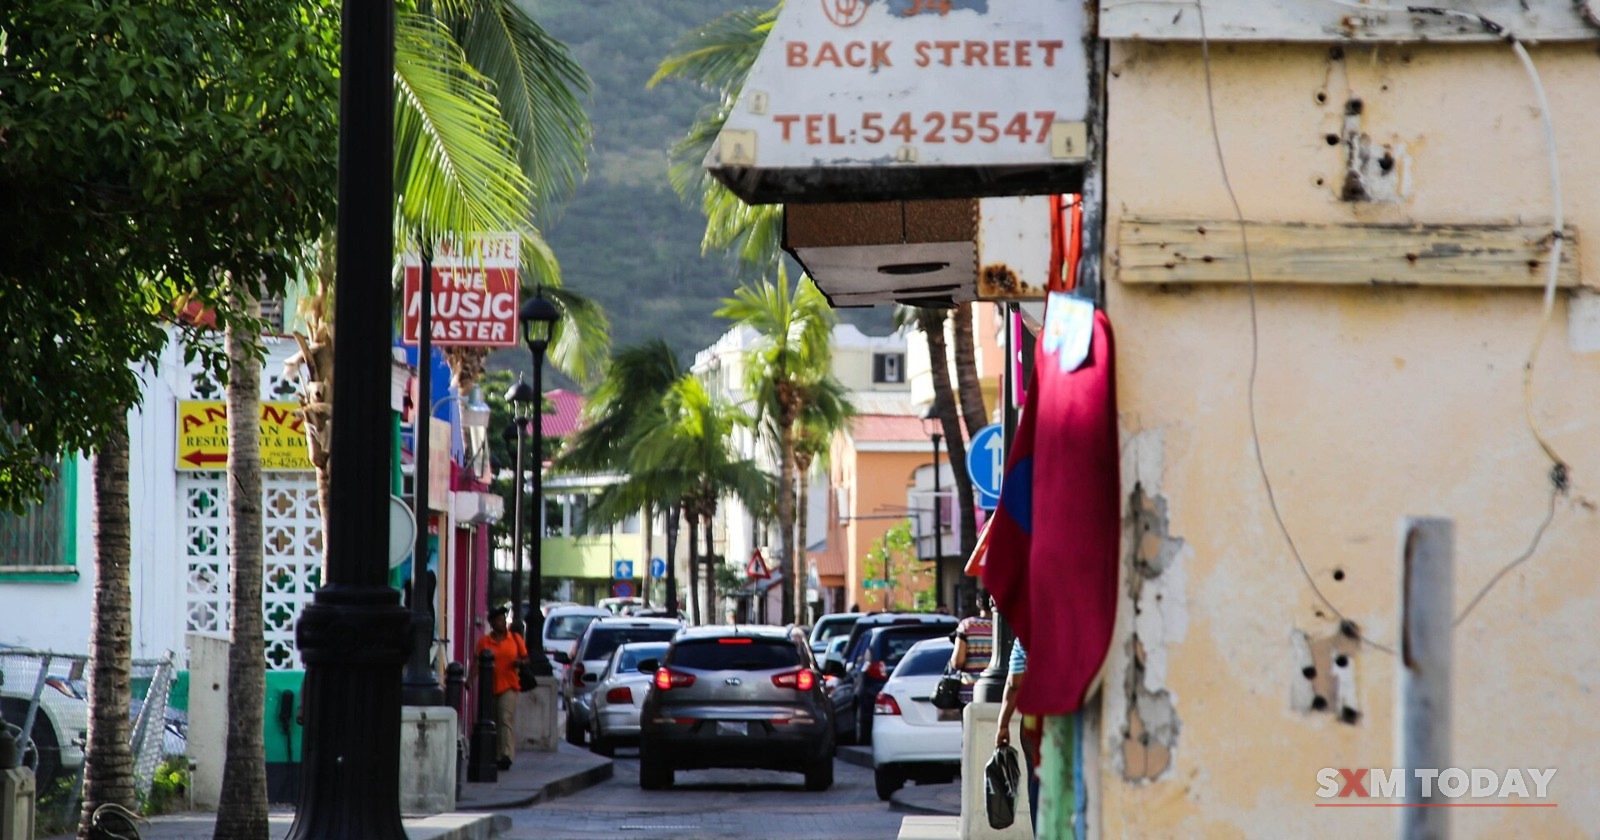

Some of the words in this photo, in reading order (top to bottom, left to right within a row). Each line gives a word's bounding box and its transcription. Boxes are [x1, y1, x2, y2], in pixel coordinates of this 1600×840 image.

[785, 40, 893, 69] BACK
[914, 39, 1064, 68] STREET
[439, 271, 487, 289] THE
[273, 436, 283, 447] &
